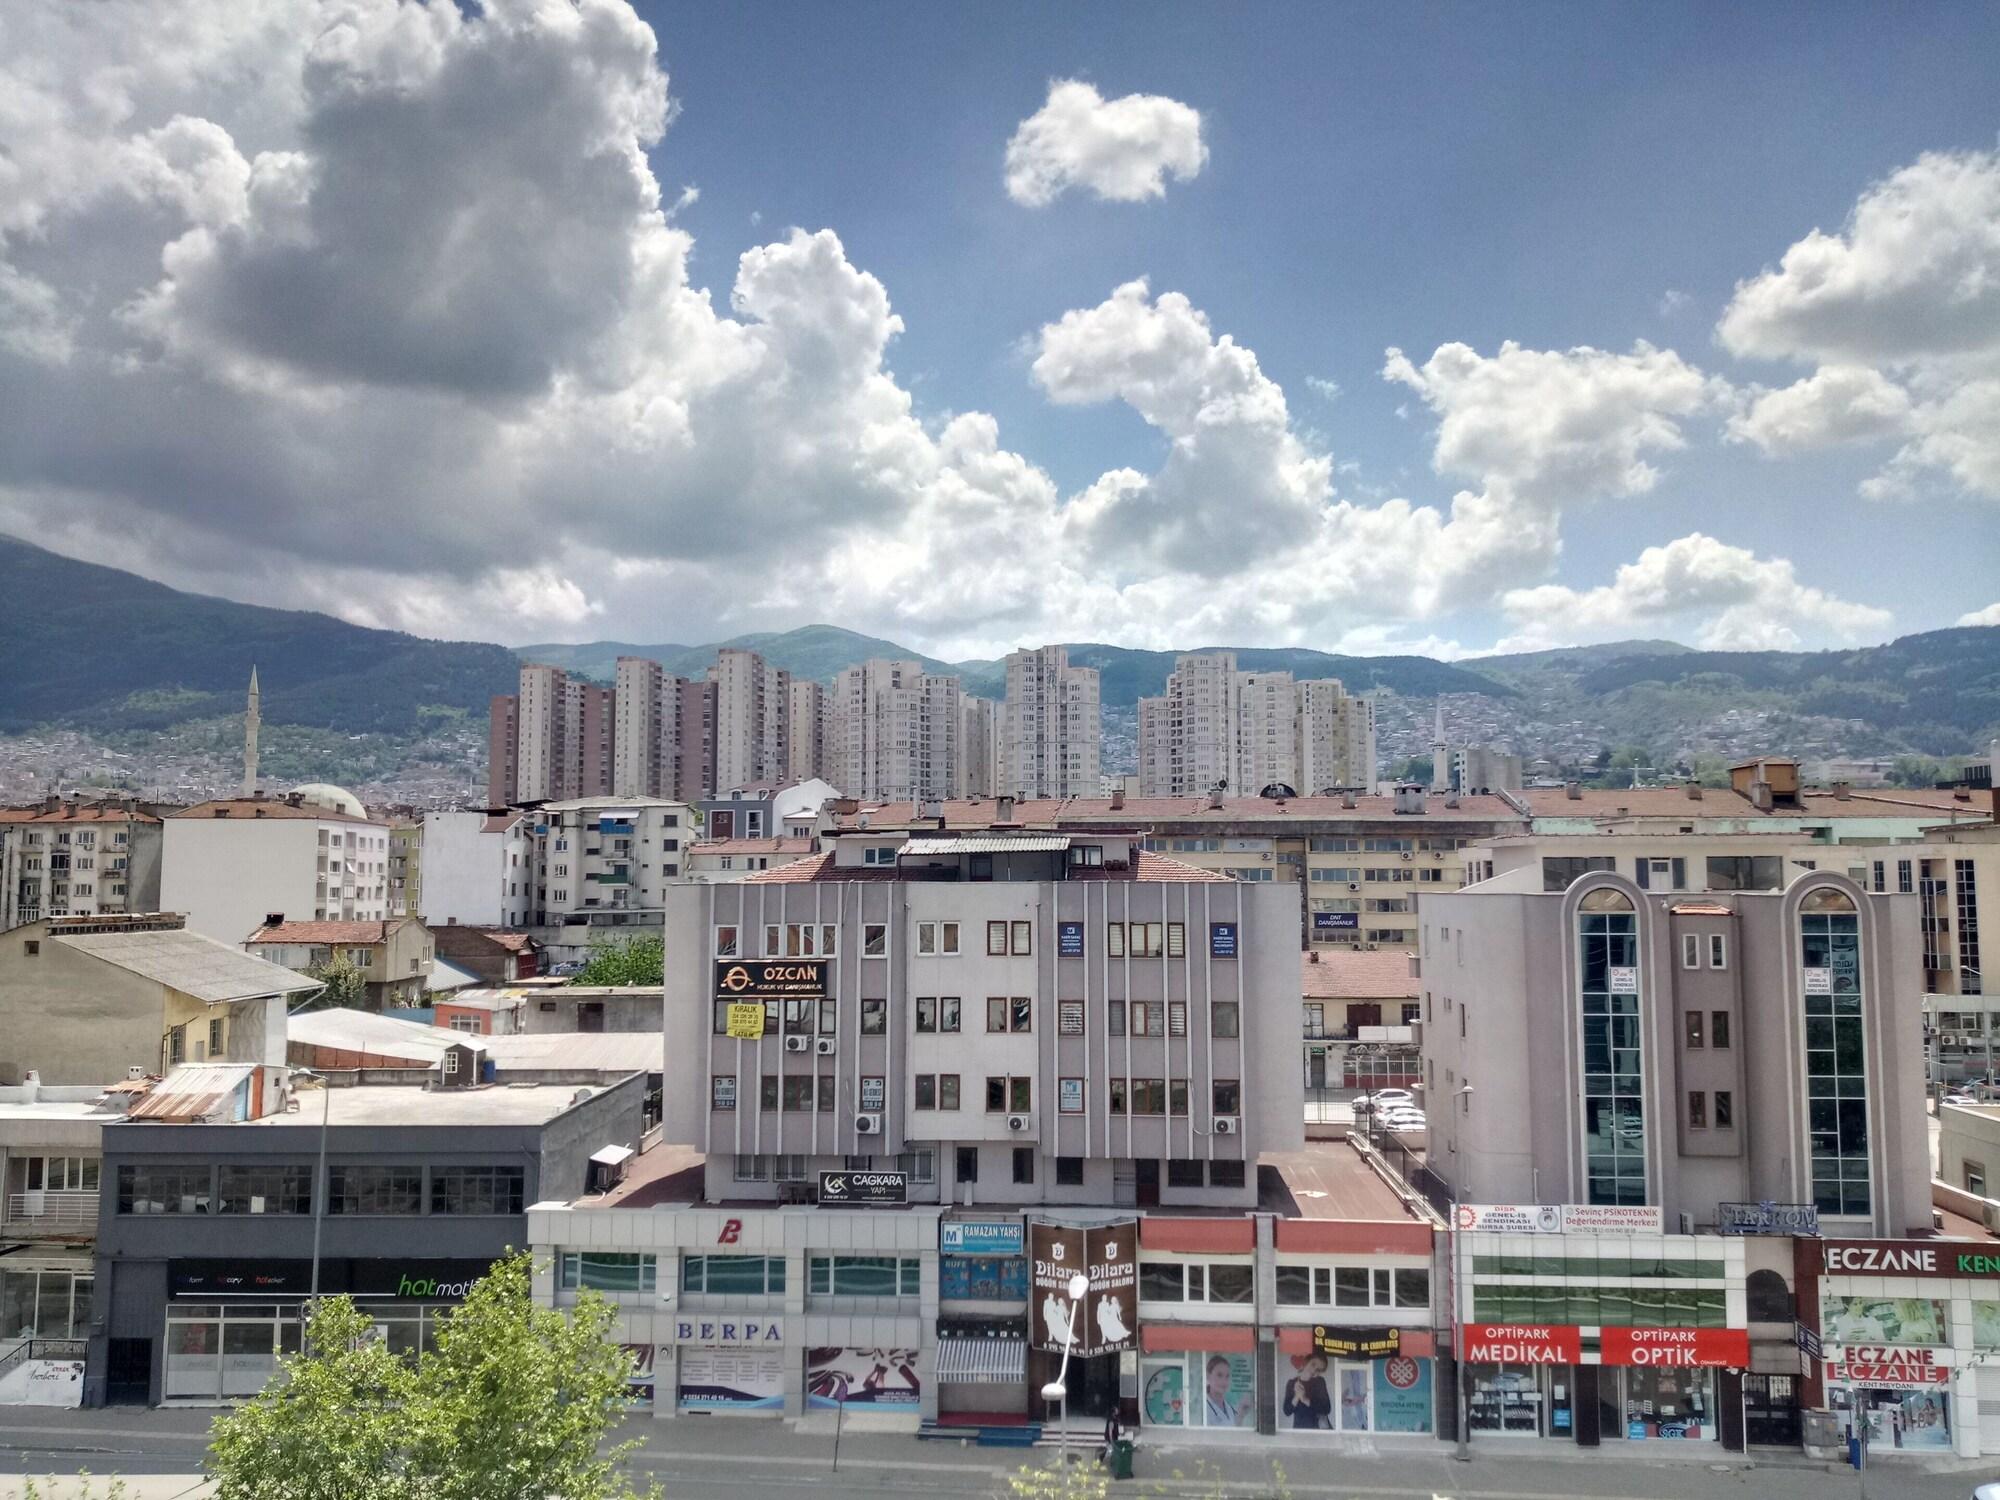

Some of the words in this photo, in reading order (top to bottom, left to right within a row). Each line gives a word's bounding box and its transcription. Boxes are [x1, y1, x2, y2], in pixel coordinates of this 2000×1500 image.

[1575, 1207, 1601, 1217] Sevinç
[964, 1226, 998, 1237] RAMAZAN
[1627, 1218, 1658, 1227] Merkezi
[1827, 1248, 1937, 1272] ECZANE
[1090, 1262, 1133, 1281] Dilara
[678, 1323, 782, 1341] BERPA
[1485, 1327, 1550, 1339] OPTİPARK
[1631, 1329, 1696, 1342] OPTİPARK
[1470, 1342, 1567, 1363] MEDİKAL
[1631, 1345, 1697, 1365] OPTİK
[1845, 1347, 1934, 1365] ECZANE
[1833, 1363, 1938, 1382] ECZANE
[1858, 1381, 1878, 1389] KENT
